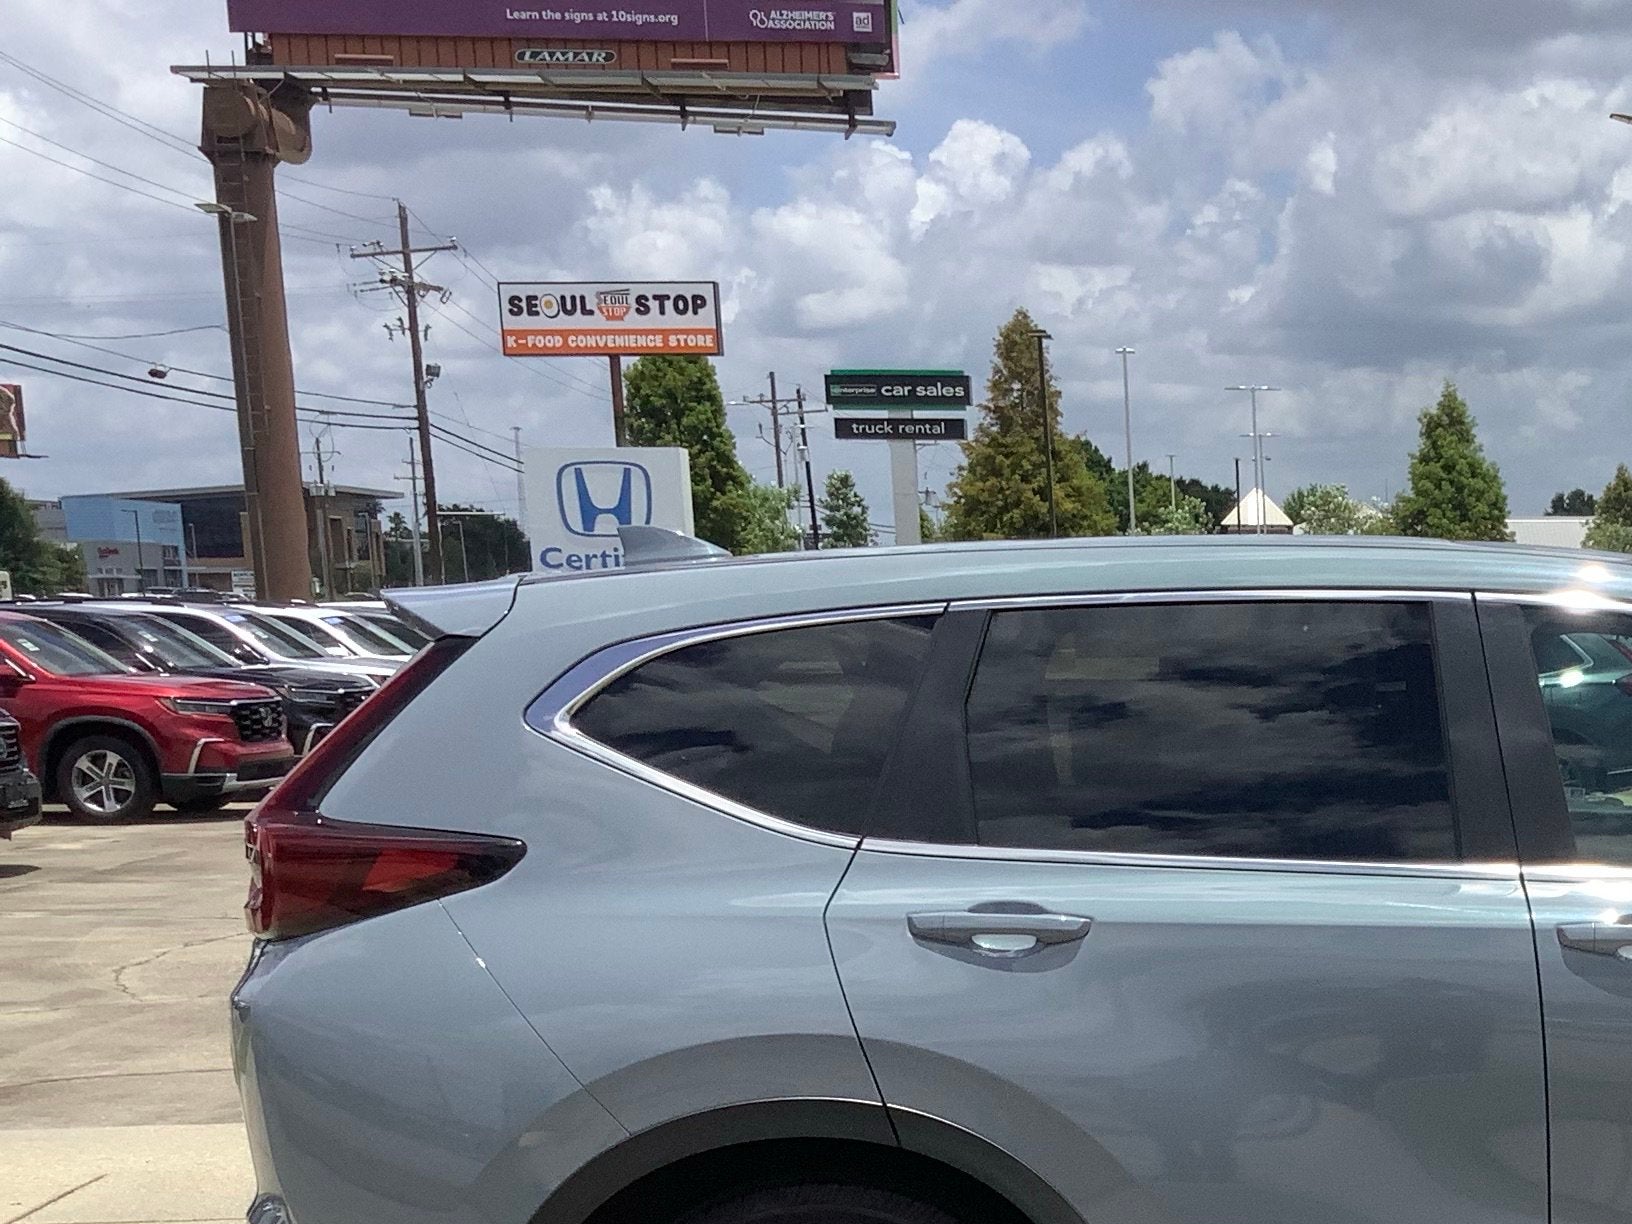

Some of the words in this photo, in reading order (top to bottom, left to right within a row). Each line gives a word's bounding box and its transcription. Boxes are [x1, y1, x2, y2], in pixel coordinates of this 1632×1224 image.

[506, 8, 540, 20] Learn
[542, 9, 562, 20] the
[564, 9, 594, 23] signs
[596, 11, 609, 21] at
[611, 10, 679, 25] 10signs.org
[767, 20, 835, 30] ASSOCIATION
[522, 50, 608, 63] LAMAR
[508, 293, 595, 318] SEOUL
[635, 294, 707, 316] STOP
[567, 335, 664, 348] CONVENIENCE
[668, 335, 714, 347] STORE
[881, 384, 912, 397] car
[916, 382, 965, 397] sales
[852, 421, 893, 434] truck
[899, 422, 945, 434] rental
[540, 547, 624, 571] Certi
